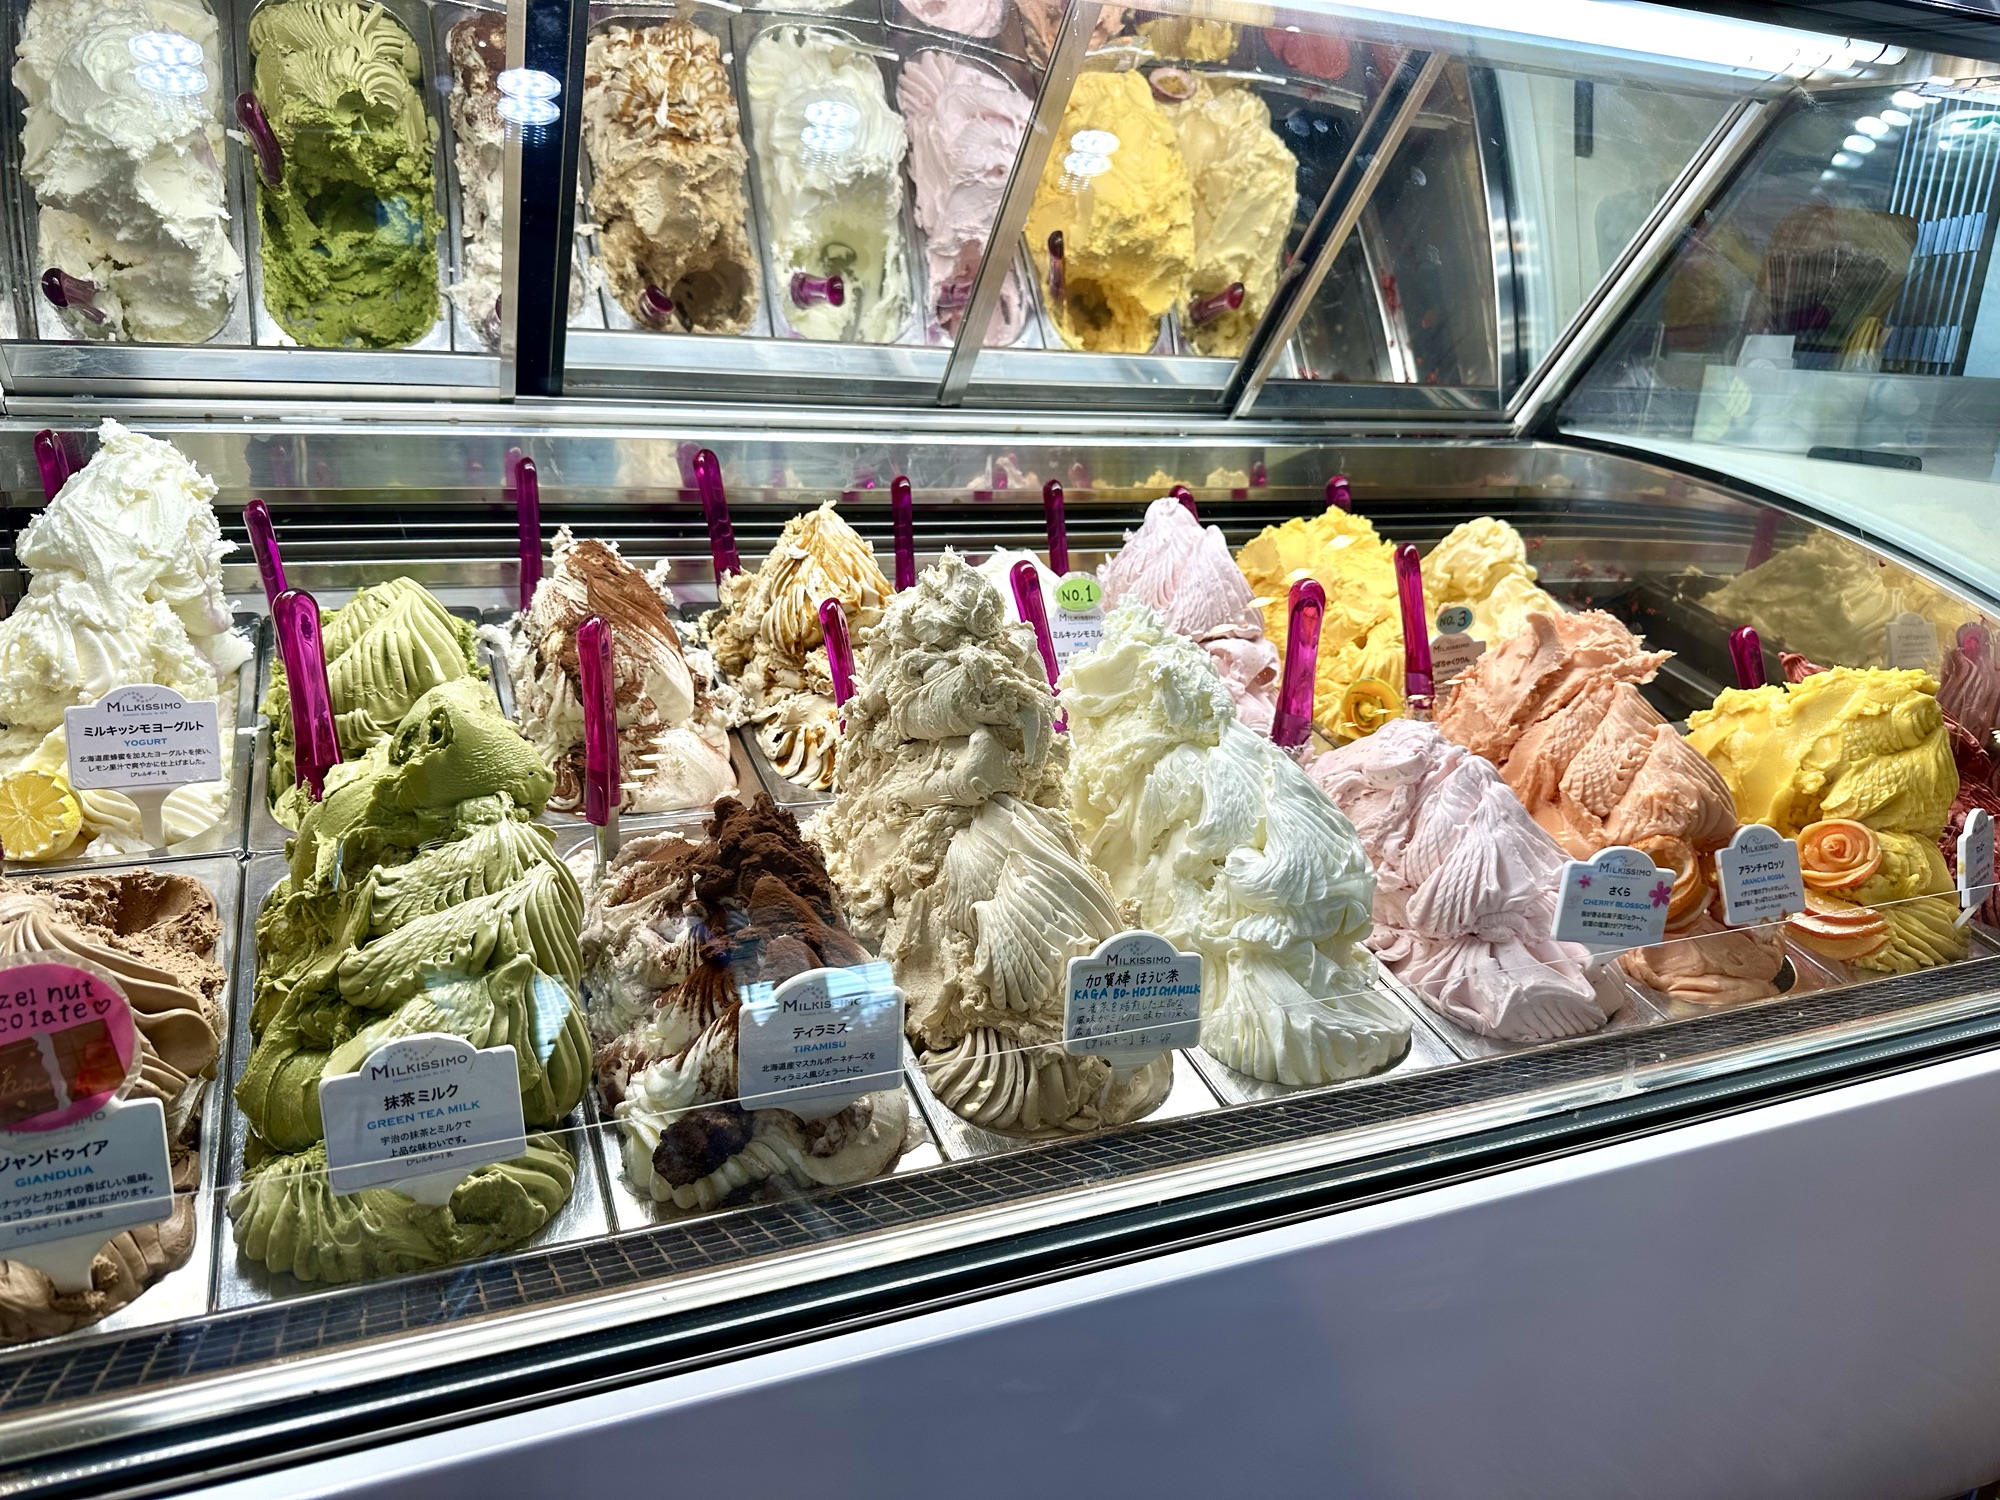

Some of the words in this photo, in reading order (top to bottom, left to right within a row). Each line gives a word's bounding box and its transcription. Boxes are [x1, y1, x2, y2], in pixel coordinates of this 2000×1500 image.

[1061, 584, 1094, 602] NO.1
[107, 702, 182, 713] MILKISSIMO
[84, 721, 204, 737] ミルキッシモヨーグルト
[124, 738, 168, 747] YOGURT
[1740, 843, 1779, 854] MILKISSIMO
[1599, 863, 1652, 876] MILKISSIMO
[1738, 860, 1785, 875] アランチャロッソ
[1609, 886, 1631, 897] さくら
[1583, 899, 1613, 907] CHERRY
[1615, 901, 1651, 910] BLOSSOM
[1106, 954, 1171, 966] MILKISSIMO
[47, 981, 95, 1003] nut
[1074, 988, 1108, 1001] KAGA
[792, 1023, 849, 1039] ティラミス
[793, 1041, 847, 1053] TIRAMISU
[371, 1054, 468, 1081] MILKISSIMO
[762, 1052, 876, 1072] 北海道産マスカルポーネチーズを
[773, 1066, 863, 1083] ティラミス風ジェラートに。
[384, 1083, 459, 1111] 抹茶ミルク
[367, 1113, 415, 1130] GREEN
[418, 1108, 445, 1121] TEA
[447, 1100, 480, 1115] MILK
[381, 1119, 471, 1146] 宇治の抹茶とミルクで
[389, 1136, 467, 1158] 上品な味わいです。
[15, 1166, 94, 1188] GIANDUIA
[0, 1173, 153, 1210] ナッツとカカオの香ばしい風味。
